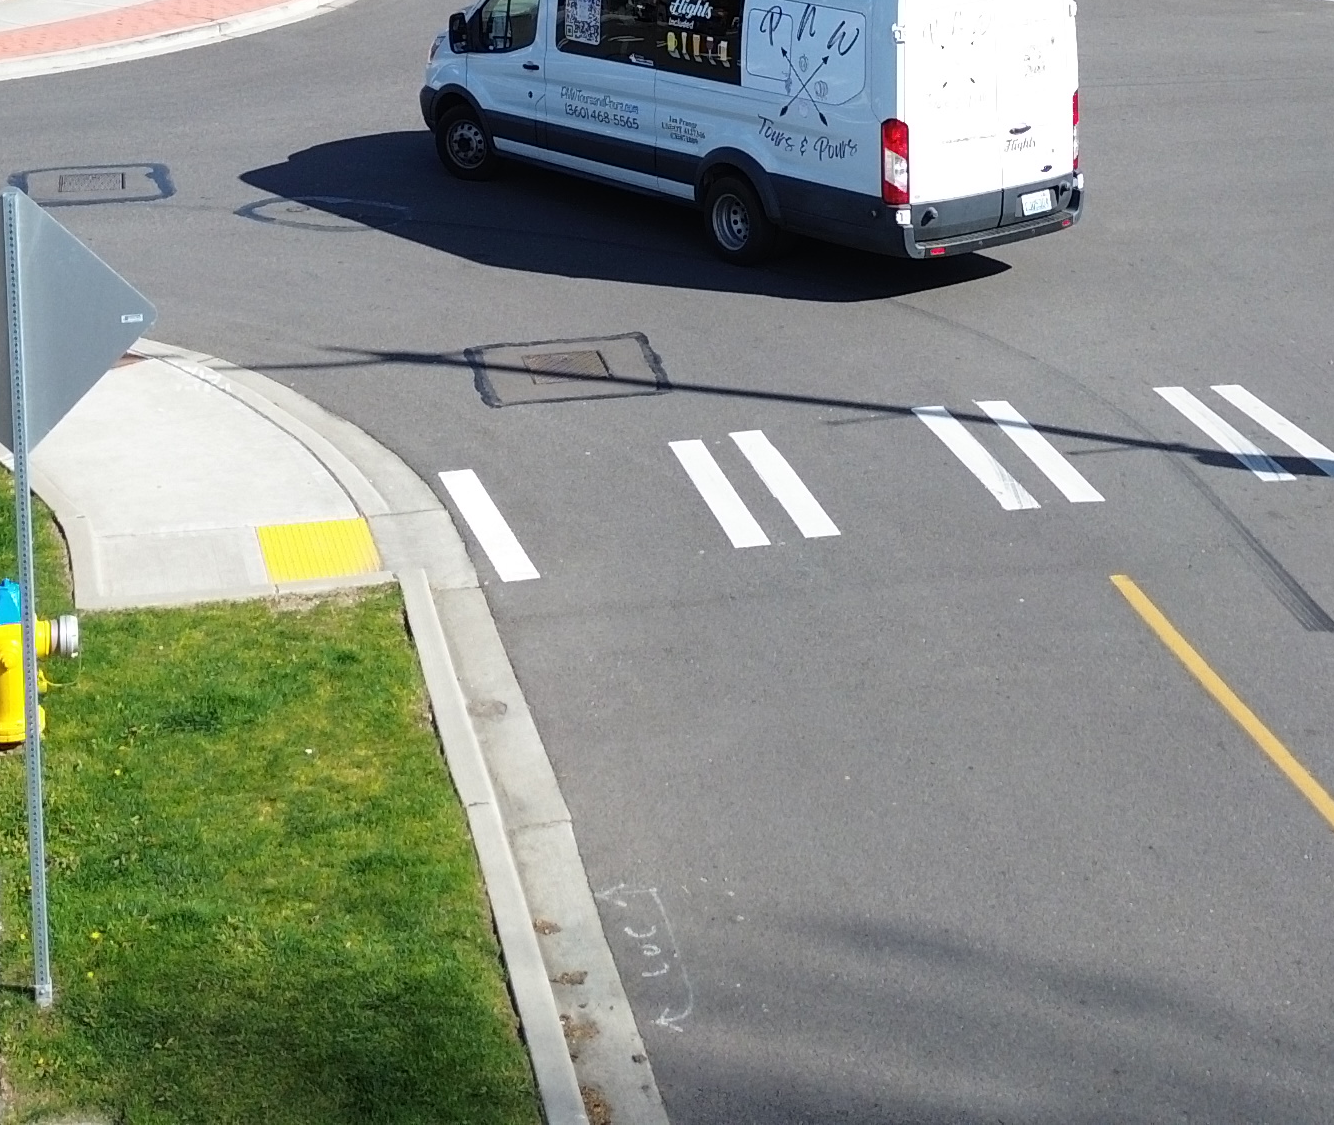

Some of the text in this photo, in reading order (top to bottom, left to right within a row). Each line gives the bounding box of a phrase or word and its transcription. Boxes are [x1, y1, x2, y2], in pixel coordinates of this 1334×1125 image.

[565, 102, 639, 130] (360) 468-5565
[758, 114, 795, 151] Tours
[814, 136, 857, 161] Pours
